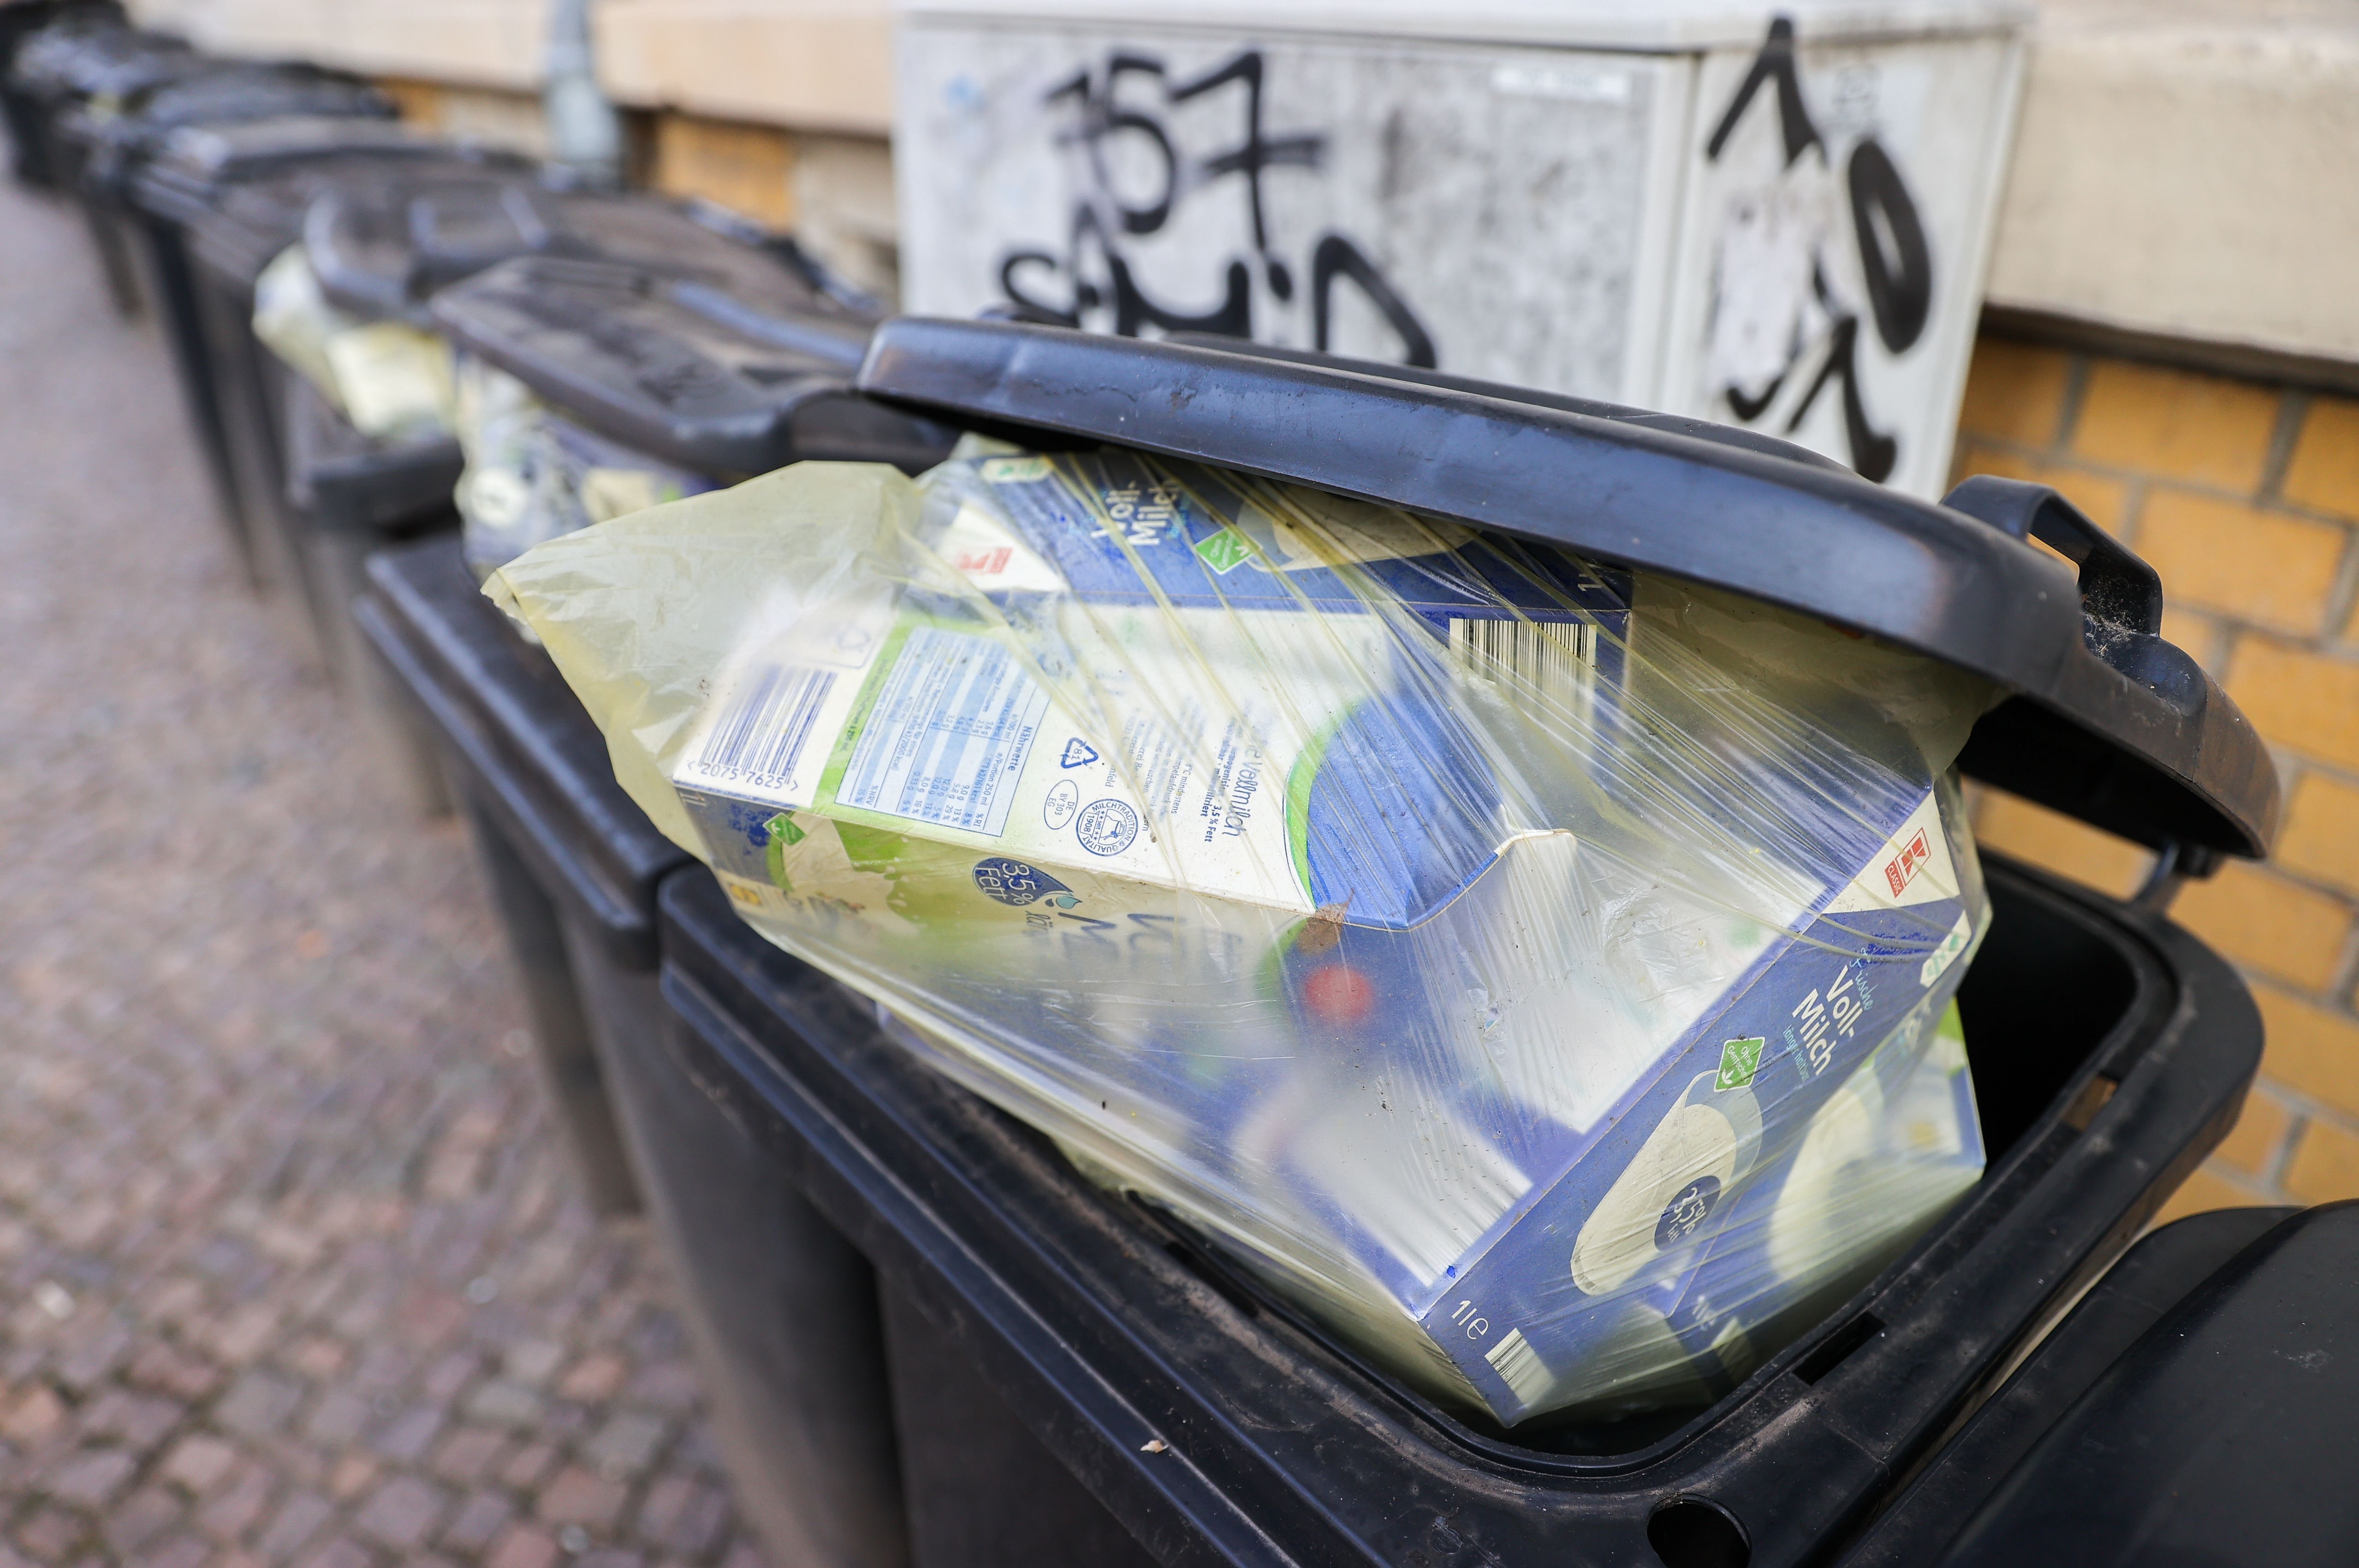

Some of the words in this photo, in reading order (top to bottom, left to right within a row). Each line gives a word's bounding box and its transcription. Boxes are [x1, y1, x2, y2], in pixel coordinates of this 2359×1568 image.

[1007, 725, 1033, 772] Nährwerte
[1070, 747, 1082, 761] 81
[969, 789, 980, 803] kcal
[982, 782, 992, 796] 250
[1170, 776, 1188, 814] mindestens
[914, 799, 922, 808] 16
[979, 796, 988, 806] ml
[1046, 797, 1056, 807] EG
[1058, 793, 1068, 802] BY
[944, 804, 953, 814] 29
[953, 807, 962, 816] 13
[1054, 802, 1064, 816] 303
[1065, 801, 1075, 811] DE
[1211, 804, 1222, 817] 3,5
[1083, 815, 1095, 832] 1908
[1092, 802, 1135, 841] MILCHTRADITION
[1204, 825, 1217, 843] Fett
[1082, 836, 1117, 853] QUALITÄT
[974, 866, 1008, 900] Fett
[1888, 864, 1902, 895] CLASSIC
[1826, 964, 1864, 1038] Voll-
[1791, 988, 1837, 1076] Milch
[1741, 1046, 1753, 1066] Ohne
[1727, 1045, 1749, 1084] Gentechnk
